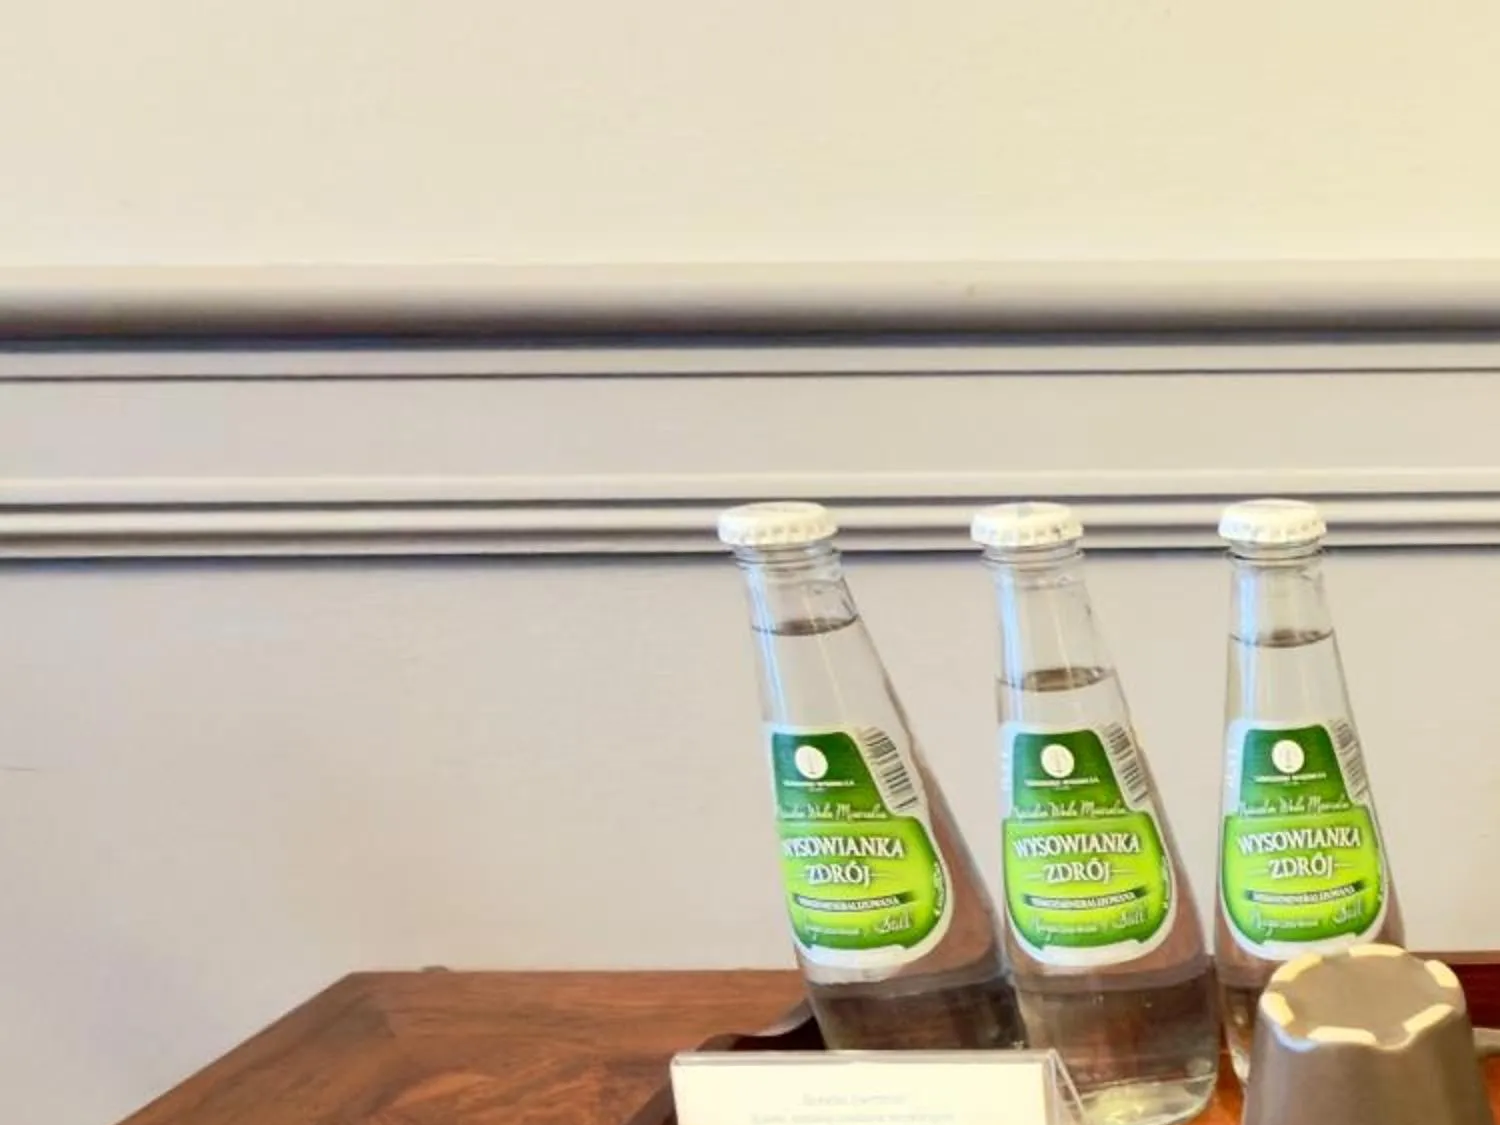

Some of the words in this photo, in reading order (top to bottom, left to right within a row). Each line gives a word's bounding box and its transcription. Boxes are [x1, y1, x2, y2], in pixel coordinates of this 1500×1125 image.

[1012, 833, 1140, 857] WYSOWIANKA
[1239, 827, 1361, 854] WYSOWIANKA
[805, 861, 870, 888] ZDRÓJ
[1043, 858, 1111, 884] ZDRÓJ
[1268, 852, 1333, 879] ZDRÓJ
